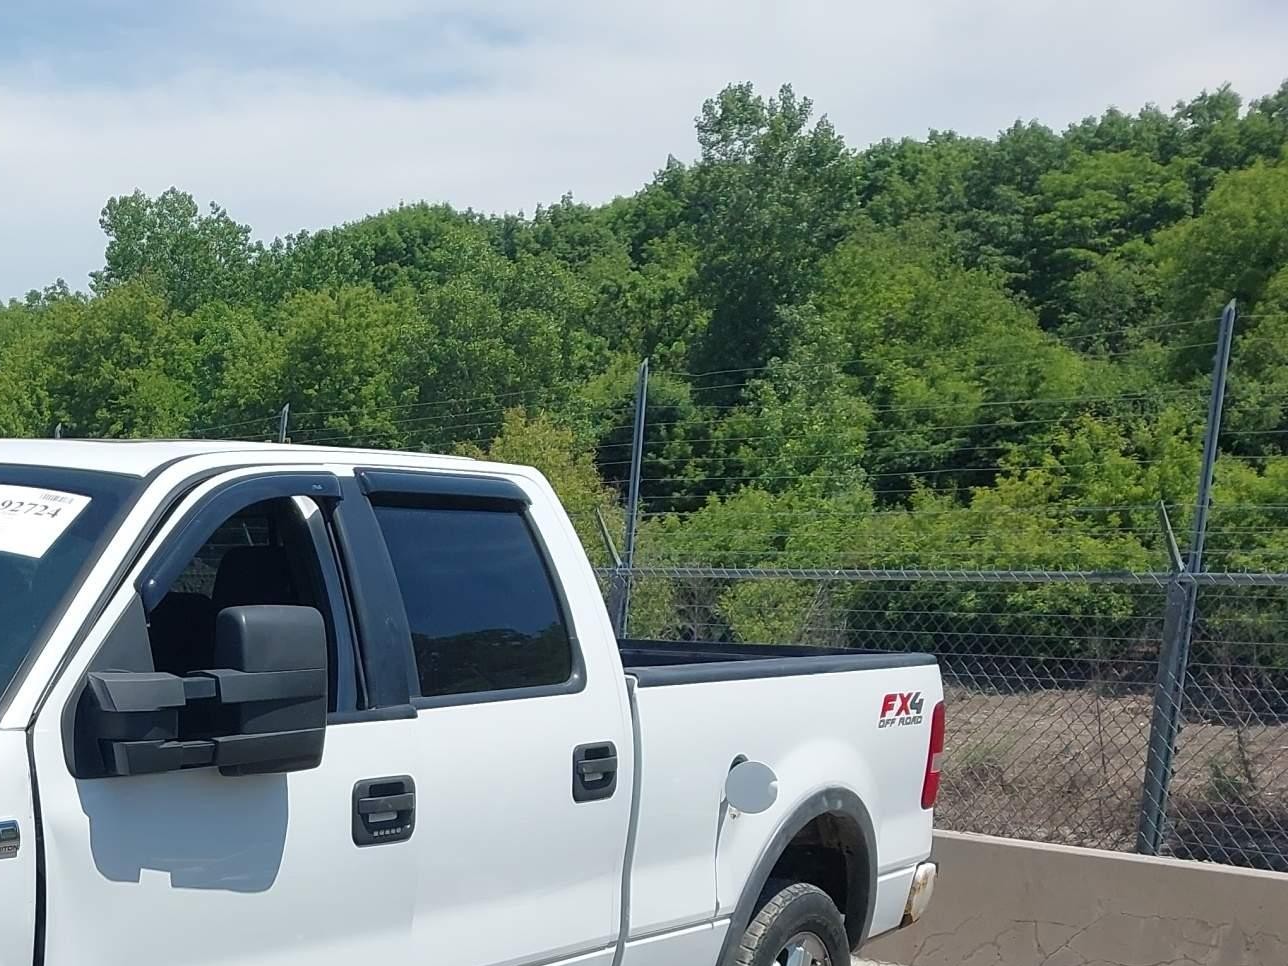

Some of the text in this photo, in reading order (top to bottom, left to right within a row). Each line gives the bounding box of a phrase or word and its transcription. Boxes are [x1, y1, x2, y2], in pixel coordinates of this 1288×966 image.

[880, 691, 924, 719] FX4
[878, 715, 923, 729] OFF ROAD
